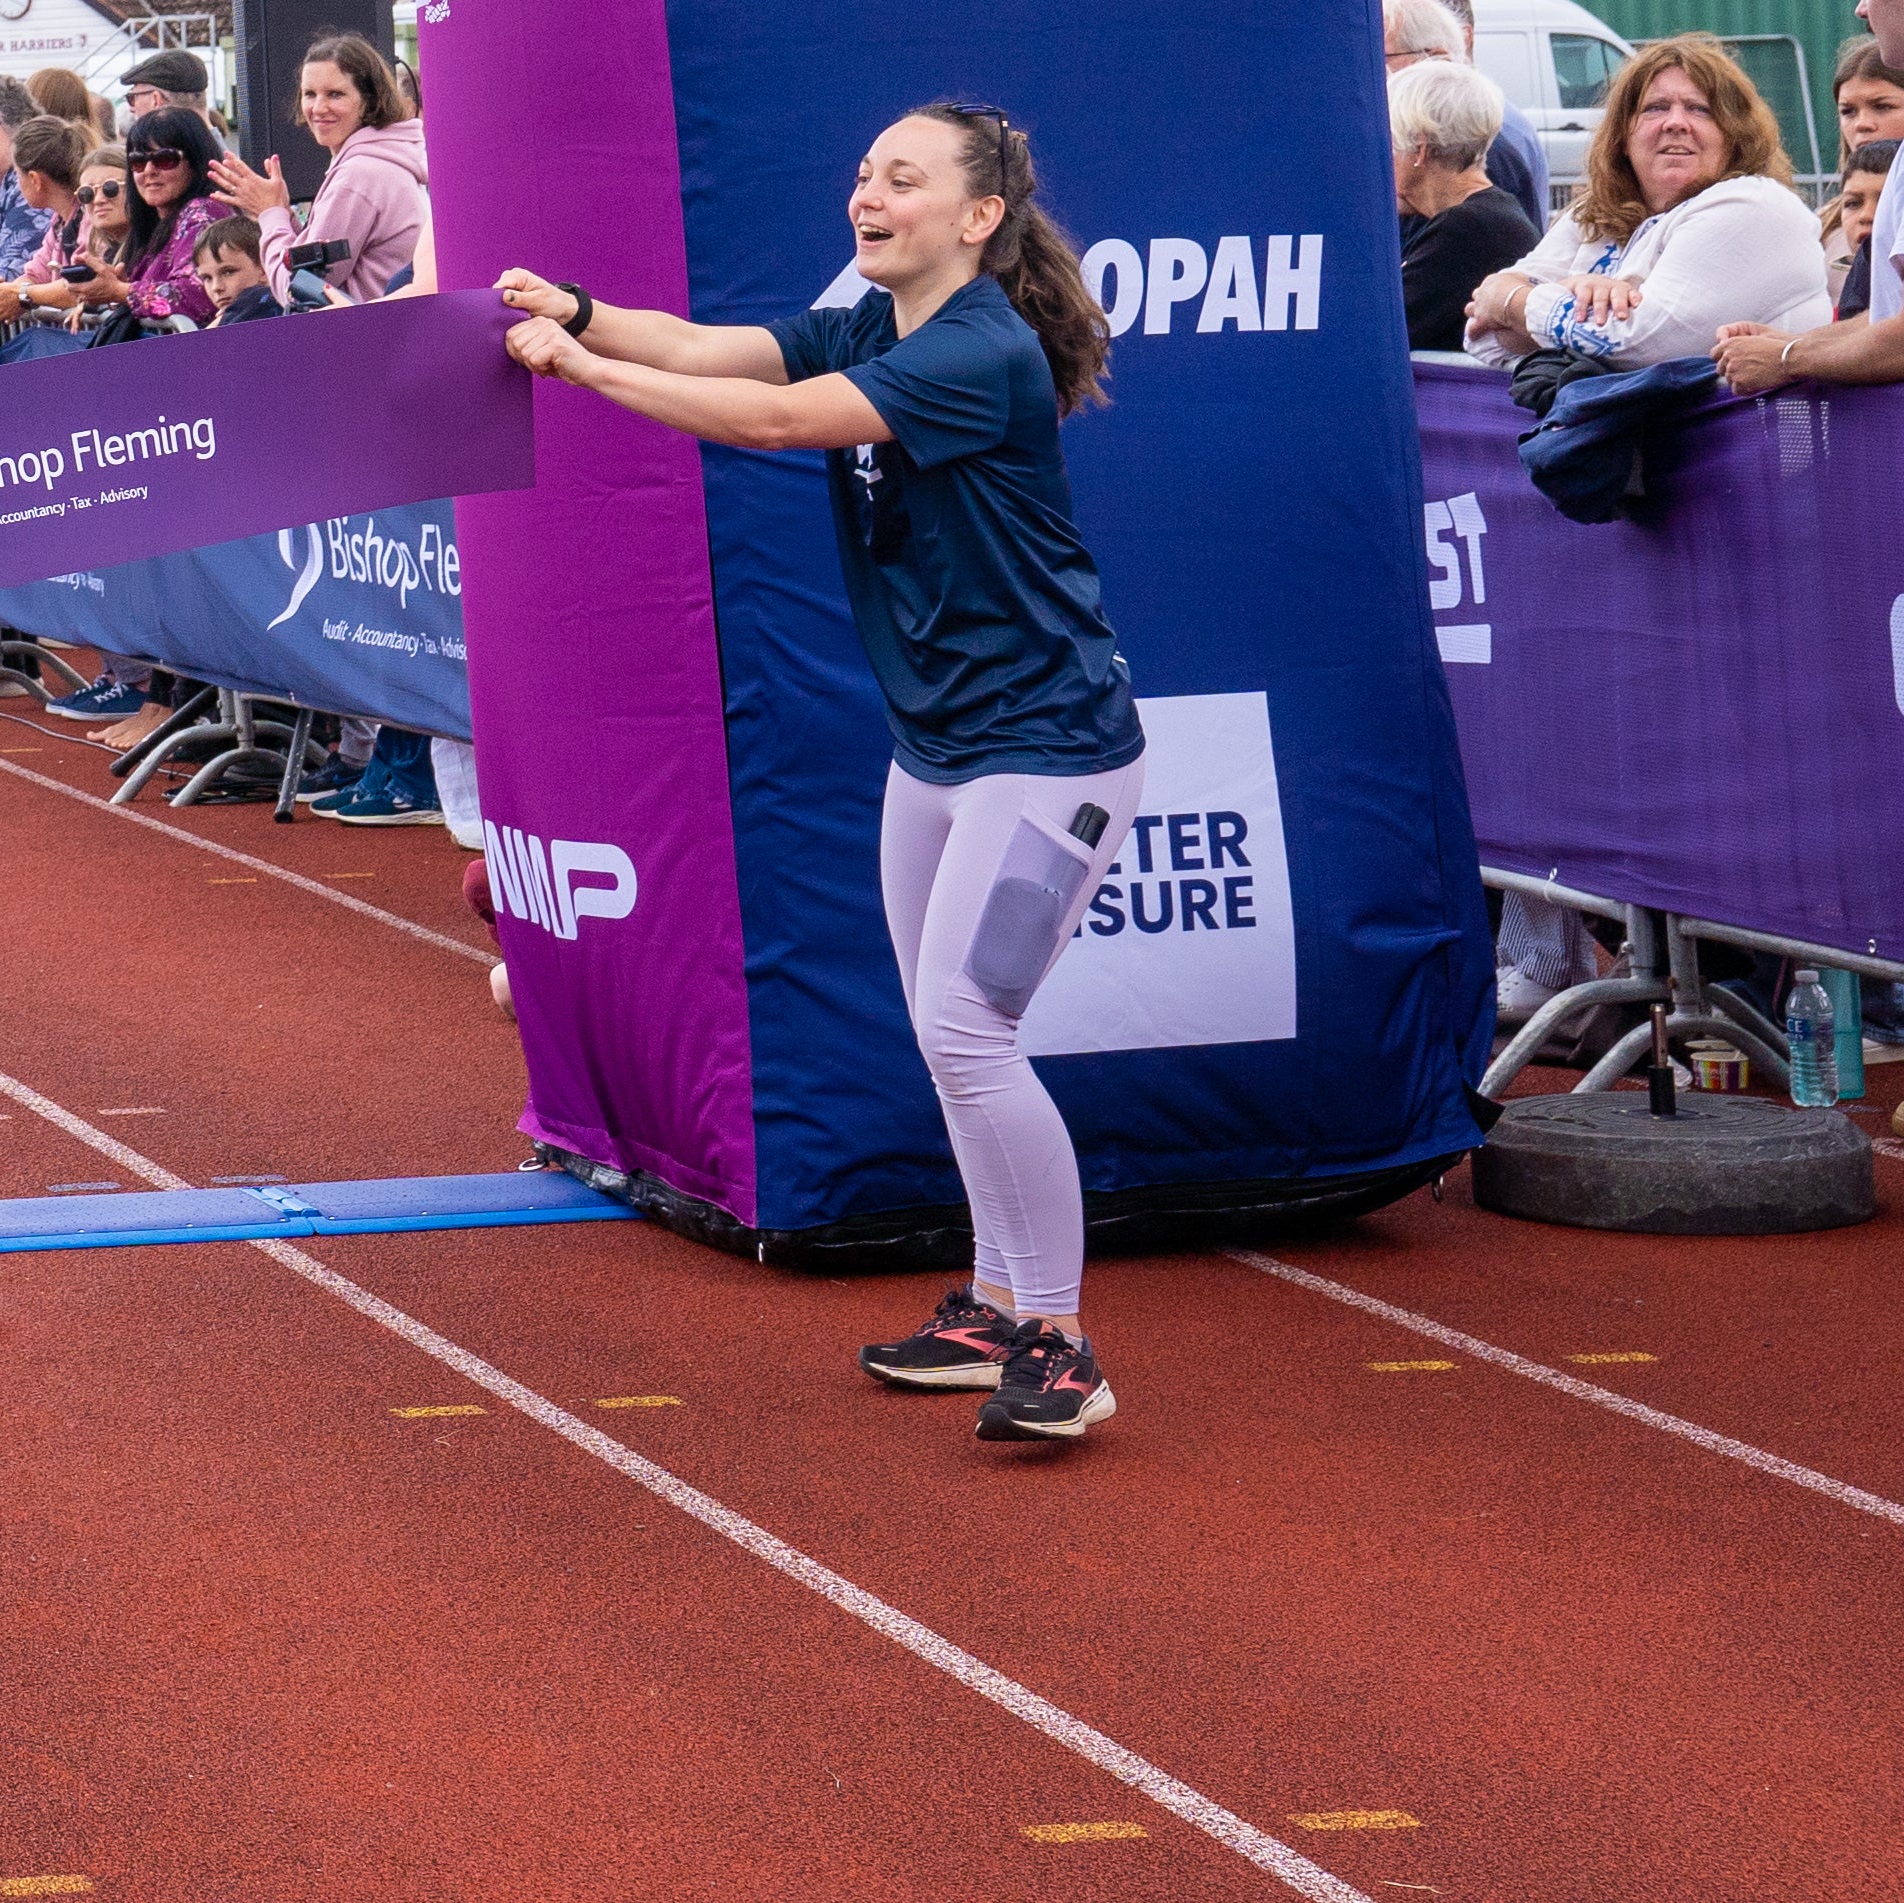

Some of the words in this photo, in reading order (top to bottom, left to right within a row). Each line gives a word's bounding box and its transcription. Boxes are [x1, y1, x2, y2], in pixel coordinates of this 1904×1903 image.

[1089, 232, 1325, 338] OPAH
[71, 416, 215, 471] Fleming
[70, 495, 92, 511] Tax
[99, 484, 149, 504] Advisory
[327, 517, 420, 608] Bishop
[322, 618, 349, 640] Audit
[352, 622, 419, 658] Accountancy
[422, 633, 438, 655] Tax
